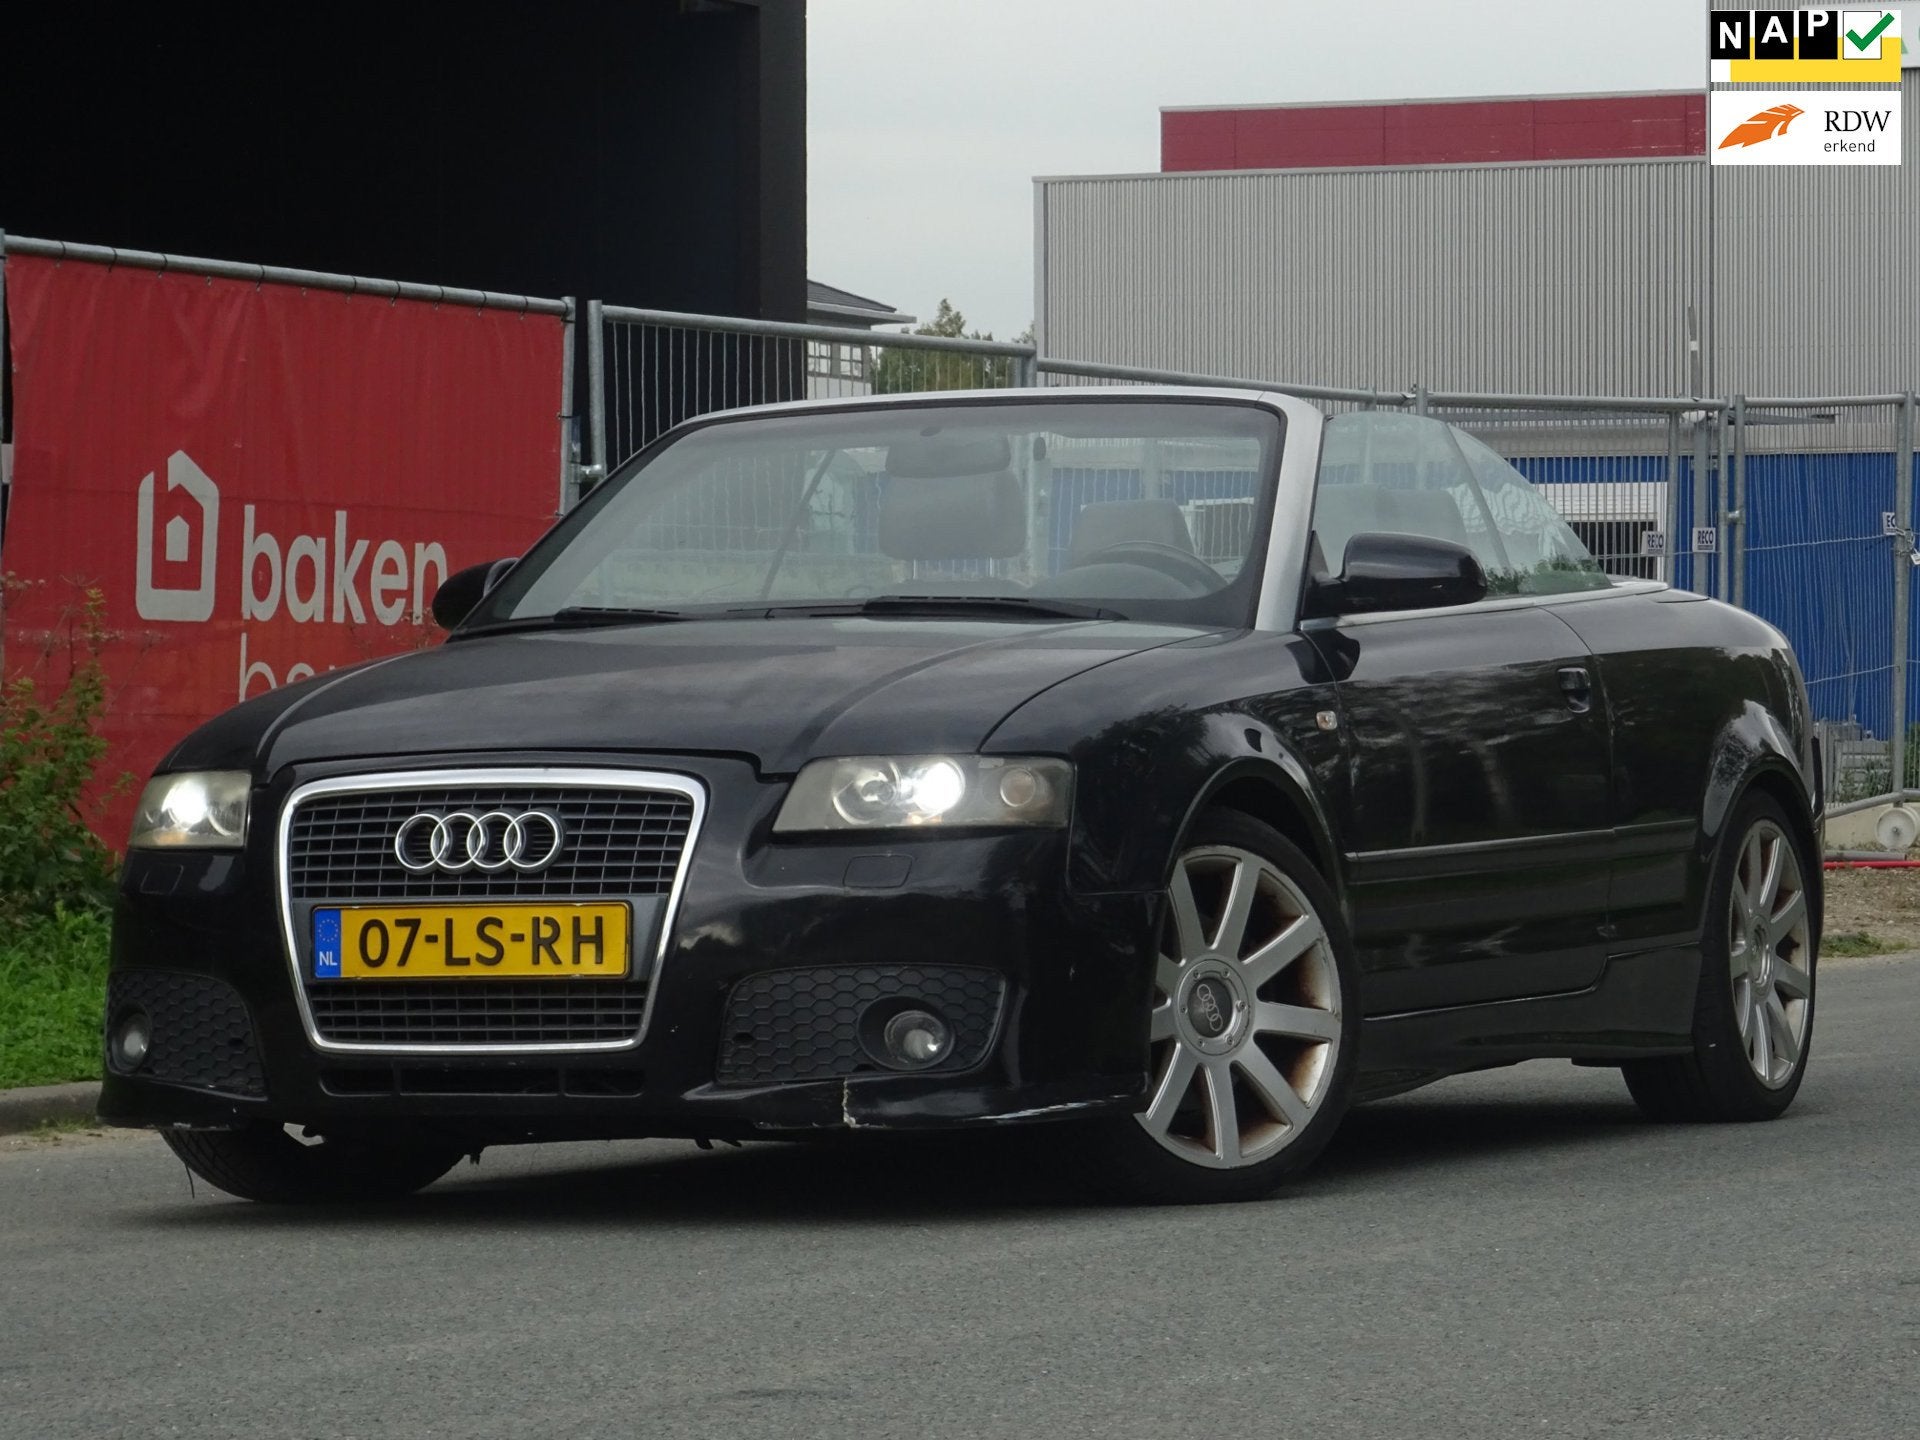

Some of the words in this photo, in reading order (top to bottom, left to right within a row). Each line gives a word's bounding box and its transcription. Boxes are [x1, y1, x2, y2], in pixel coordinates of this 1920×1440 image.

[1697, 529, 1714, 545] RECO
[241, 504, 448, 626] baken
[358, 915, 604, 968] 07-LS-RH
[318, 951, 338, 967] NL
